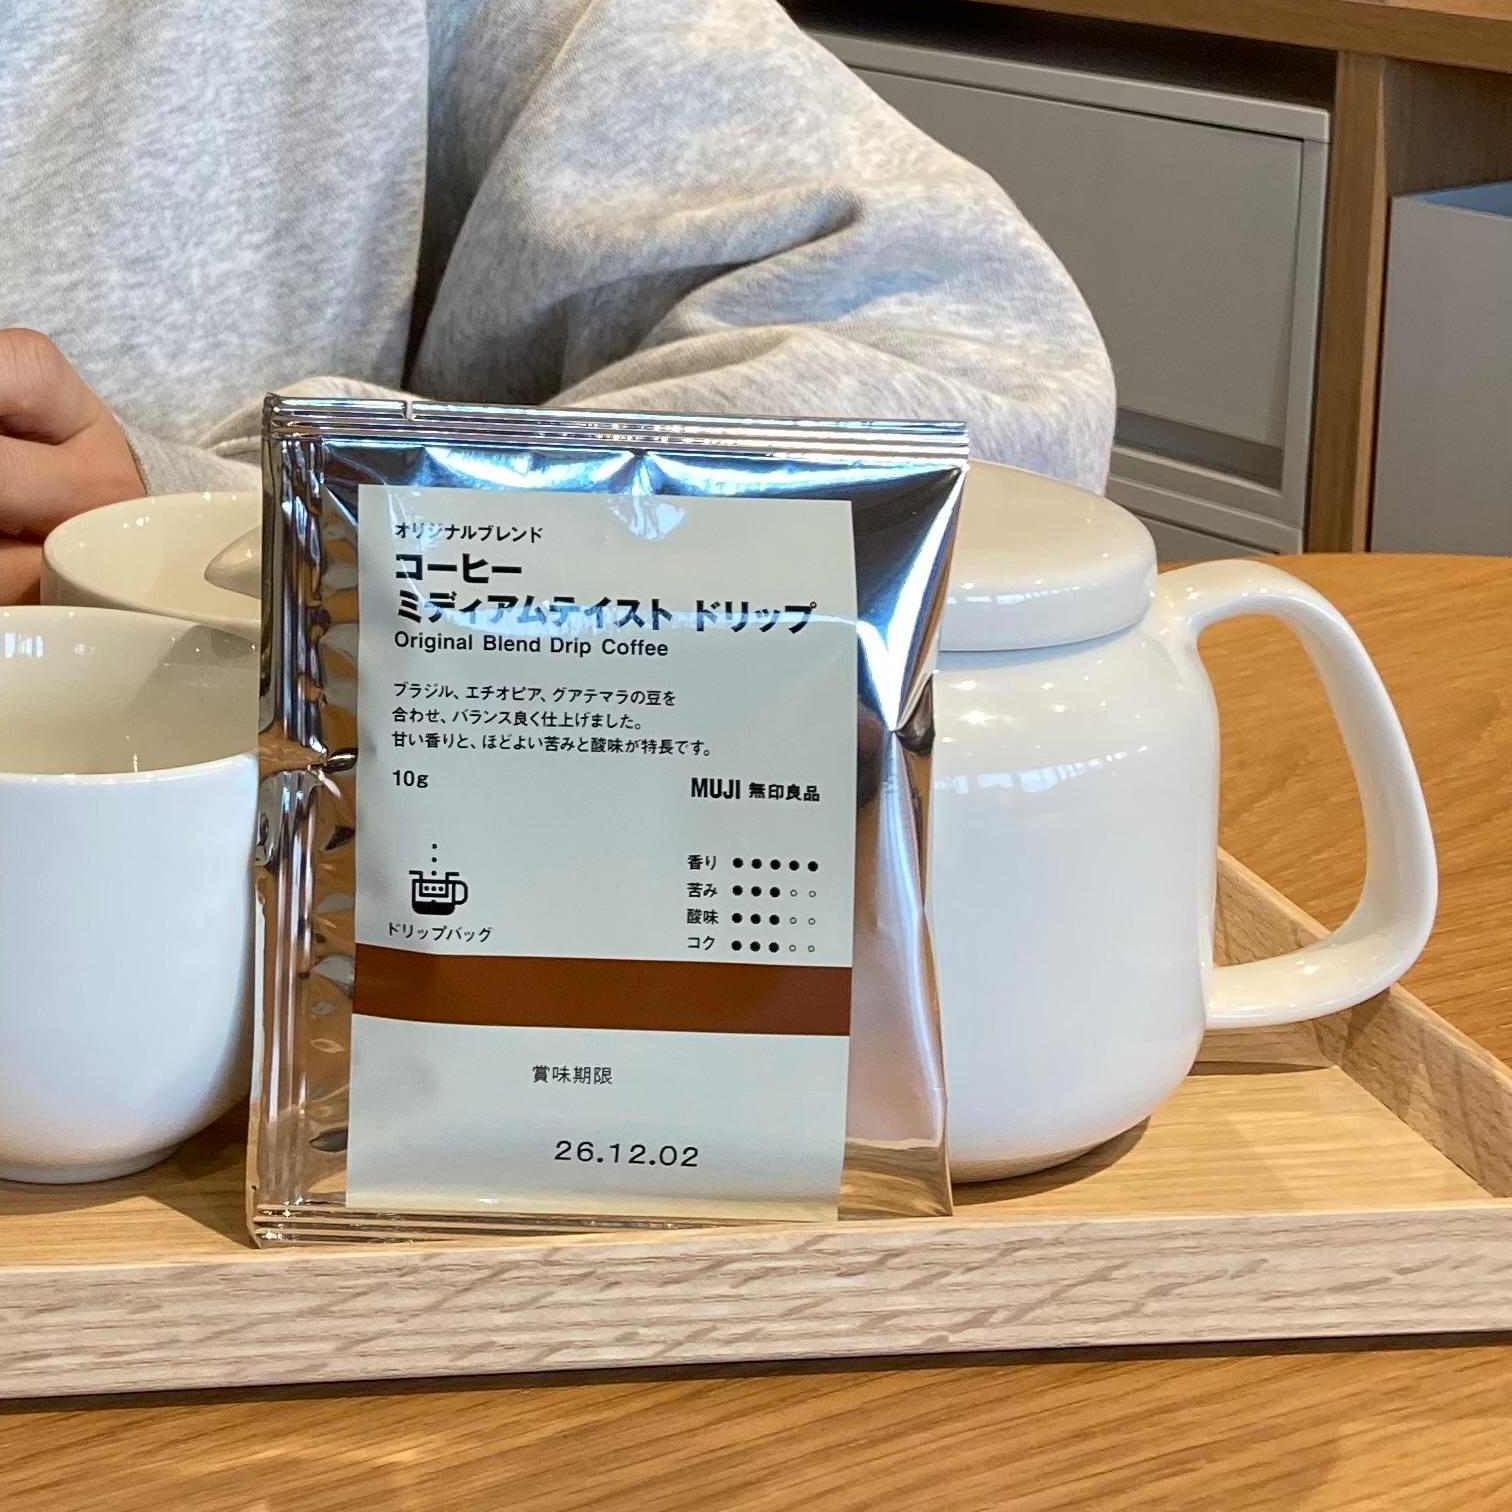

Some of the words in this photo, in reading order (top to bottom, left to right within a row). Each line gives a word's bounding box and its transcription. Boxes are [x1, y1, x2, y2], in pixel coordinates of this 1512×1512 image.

[395, 522, 544, 543] オリジナルブレンド
[395, 553, 523, 584] コーヒー
[397, 589, 673, 631] ミディアムテイスト
[695, 600, 818, 634] ドリップ
[394, 631, 473, 655] Original
[483, 634, 541, 654] Blend
[551, 637, 591, 658] Drip
[602, 638, 669, 657] Coffee
[392, 770, 429, 789] 10g
[691, 777, 741, 799] MUJI
[749, 782, 820, 802] 無印良品
[687, 854, 717, 871] 香り
[687, 882, 718, 898] 苦み
[686, 908, 719, 925] 酸味
[389, 922, 494, 943] ドリップバッグ
[687, 935, 715, 951] コク
[532, 1064, 613, 1086] 賞味期限
[554, 1139, 699, 1168] 26.12.02
